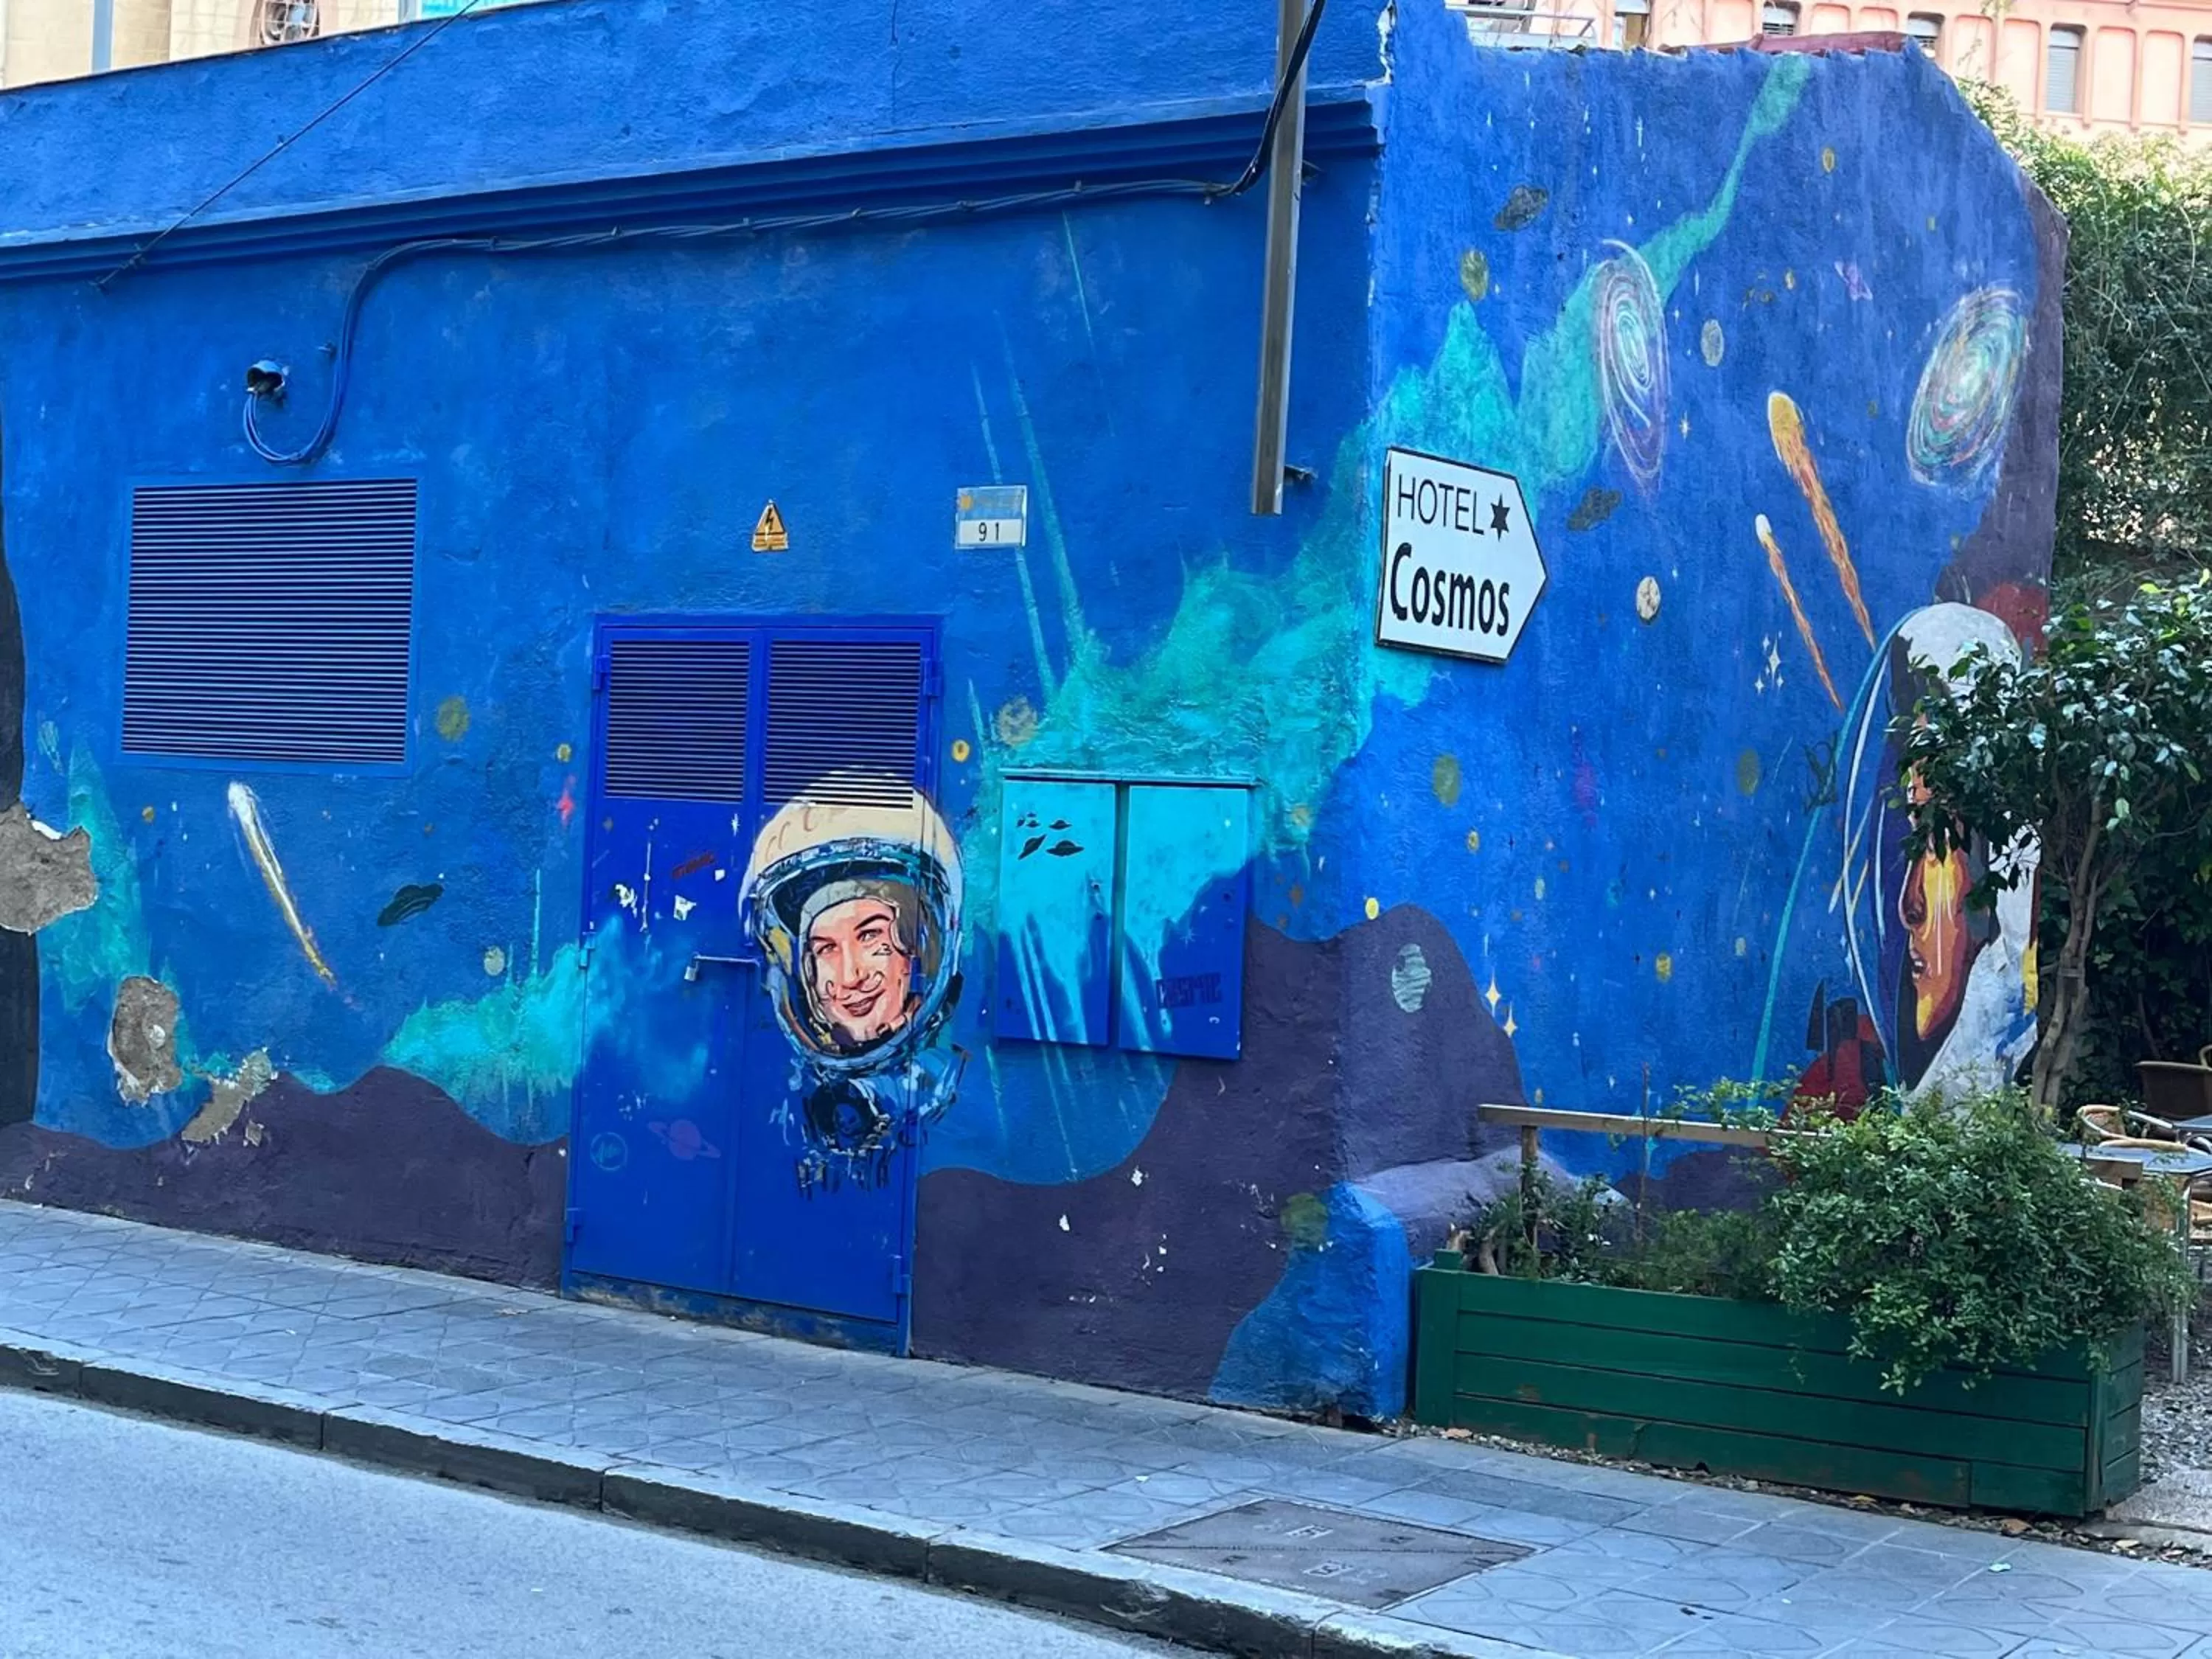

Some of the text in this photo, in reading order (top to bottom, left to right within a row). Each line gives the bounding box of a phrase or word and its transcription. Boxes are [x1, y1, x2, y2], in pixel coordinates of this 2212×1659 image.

[978, 522, 1000, 542] 91
[1397, 473, 1484, 535] HOTEL
[1390, 542, 1510, 636] Cosmos
